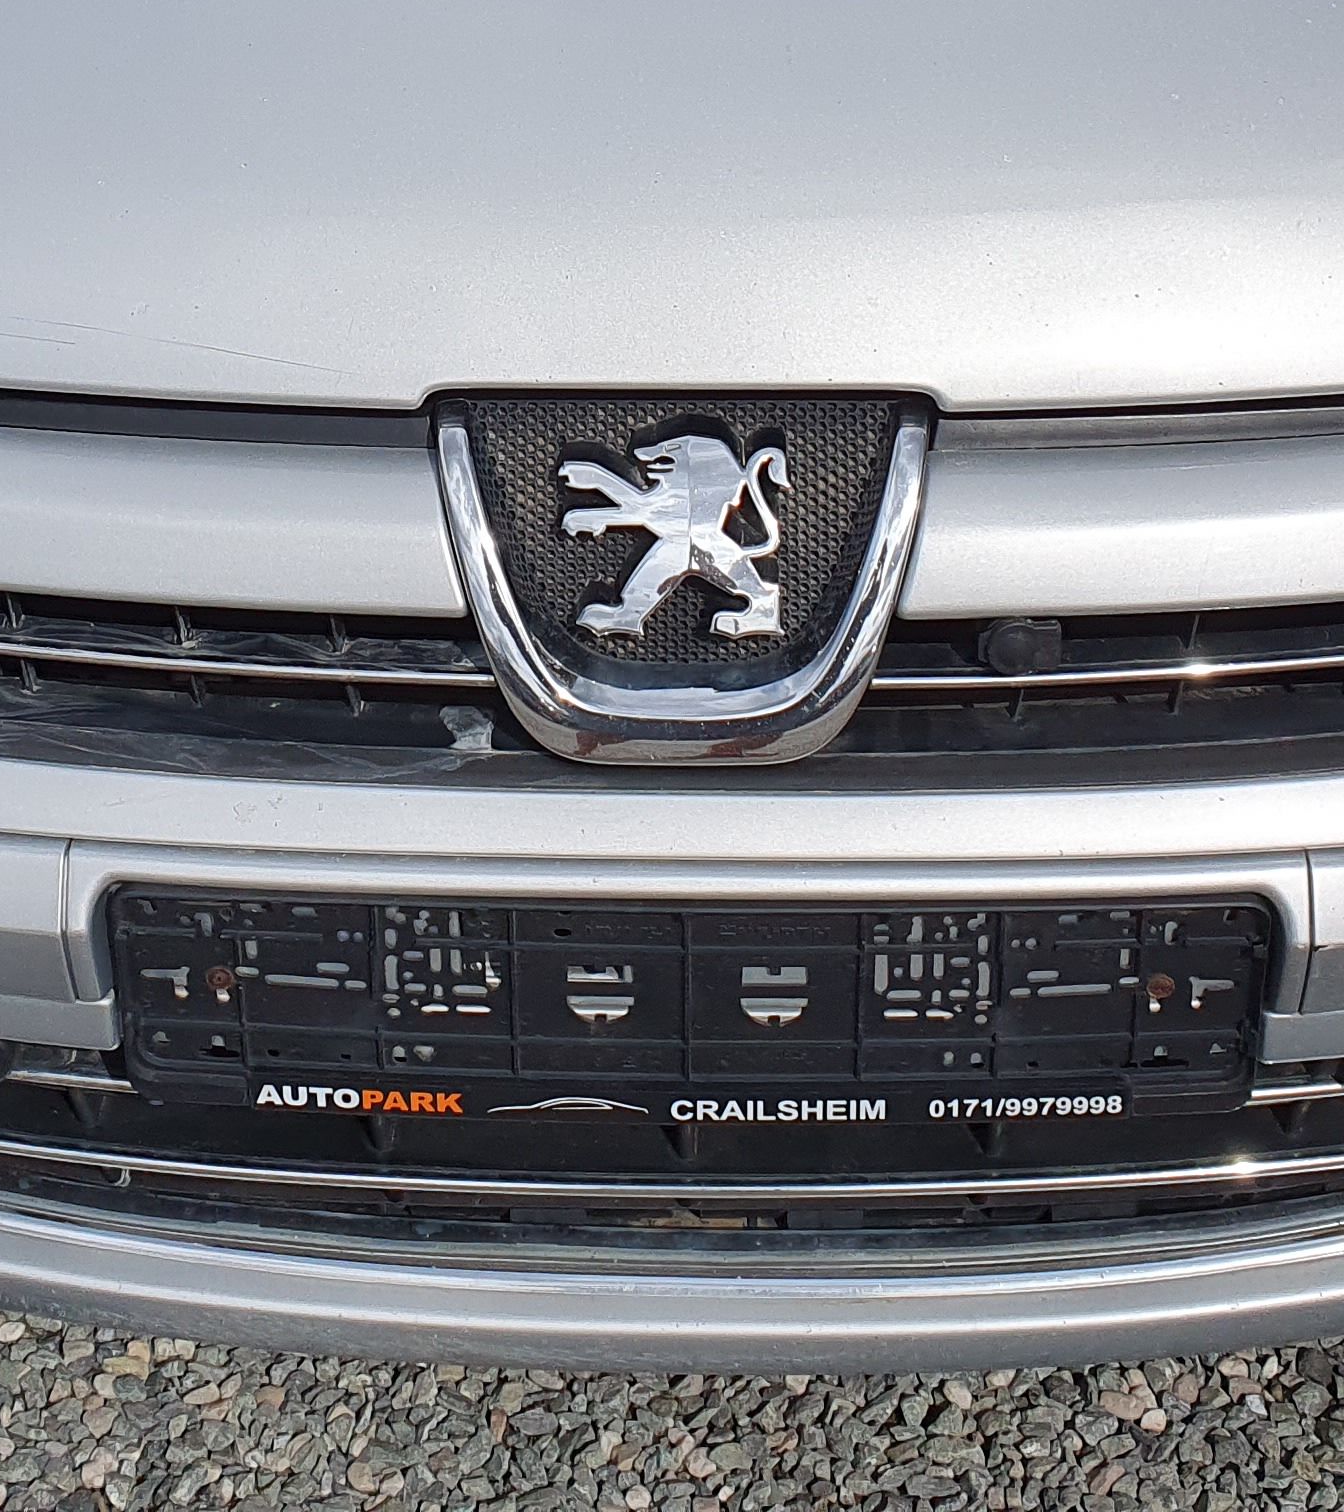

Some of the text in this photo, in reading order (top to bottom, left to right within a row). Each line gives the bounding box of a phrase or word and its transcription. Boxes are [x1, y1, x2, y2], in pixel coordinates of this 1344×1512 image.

[256, 1084, 1123, 1121] AUTOPARK CRAILSHEIM 0171/9979998
